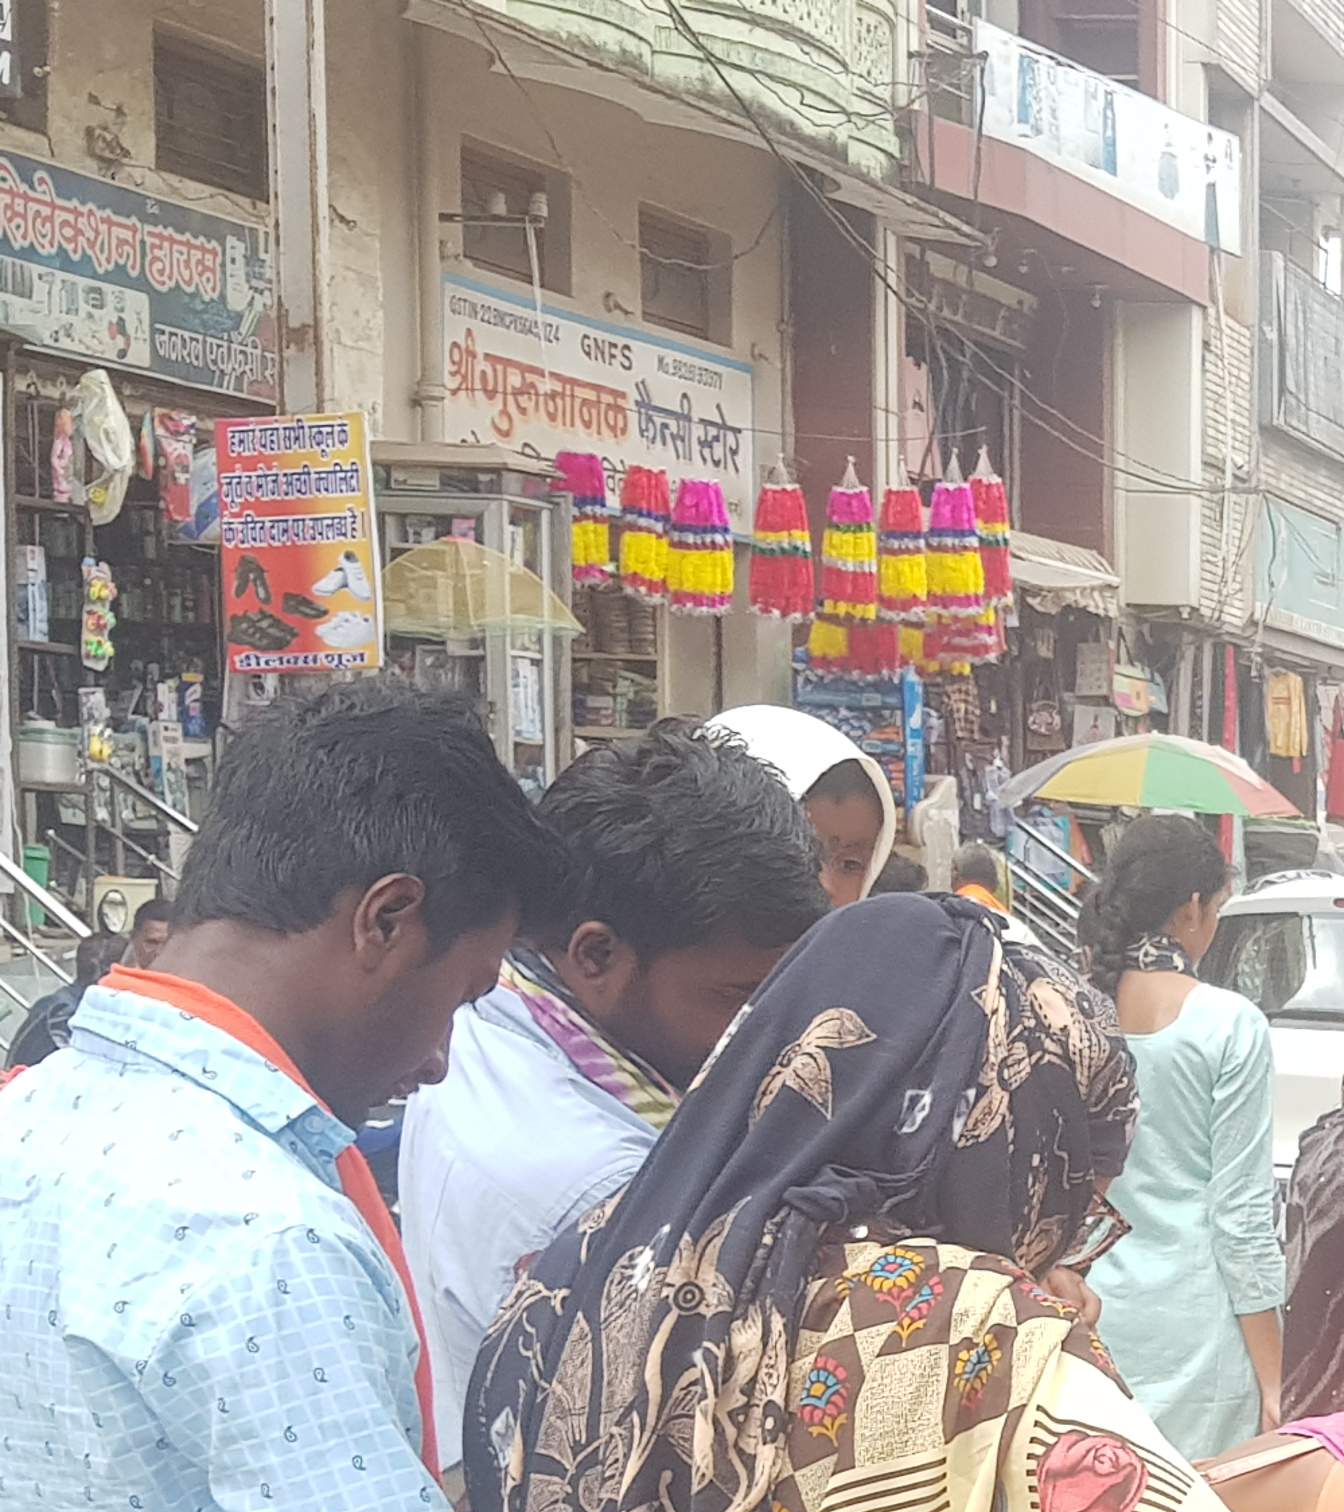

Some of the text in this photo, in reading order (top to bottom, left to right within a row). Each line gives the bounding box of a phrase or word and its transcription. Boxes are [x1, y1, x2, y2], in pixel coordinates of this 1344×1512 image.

[145, 229, 220, 294] हाउस
[580, 333, 633, 371] GNFS
[228, 420, 257, 454] हमारे
[282, 419, 305, 450] सभी
[308, 423, 335, 458] स्कूल
[336, 417, 348, 446] के
[697, 402, 742, 474] स्टोर
[222, 513, 236, 544] के
[268, 520, 289, 542] दाम
[291, 518, 307, 541] पर
[308, 516, 348, 541] उपलब्ध
